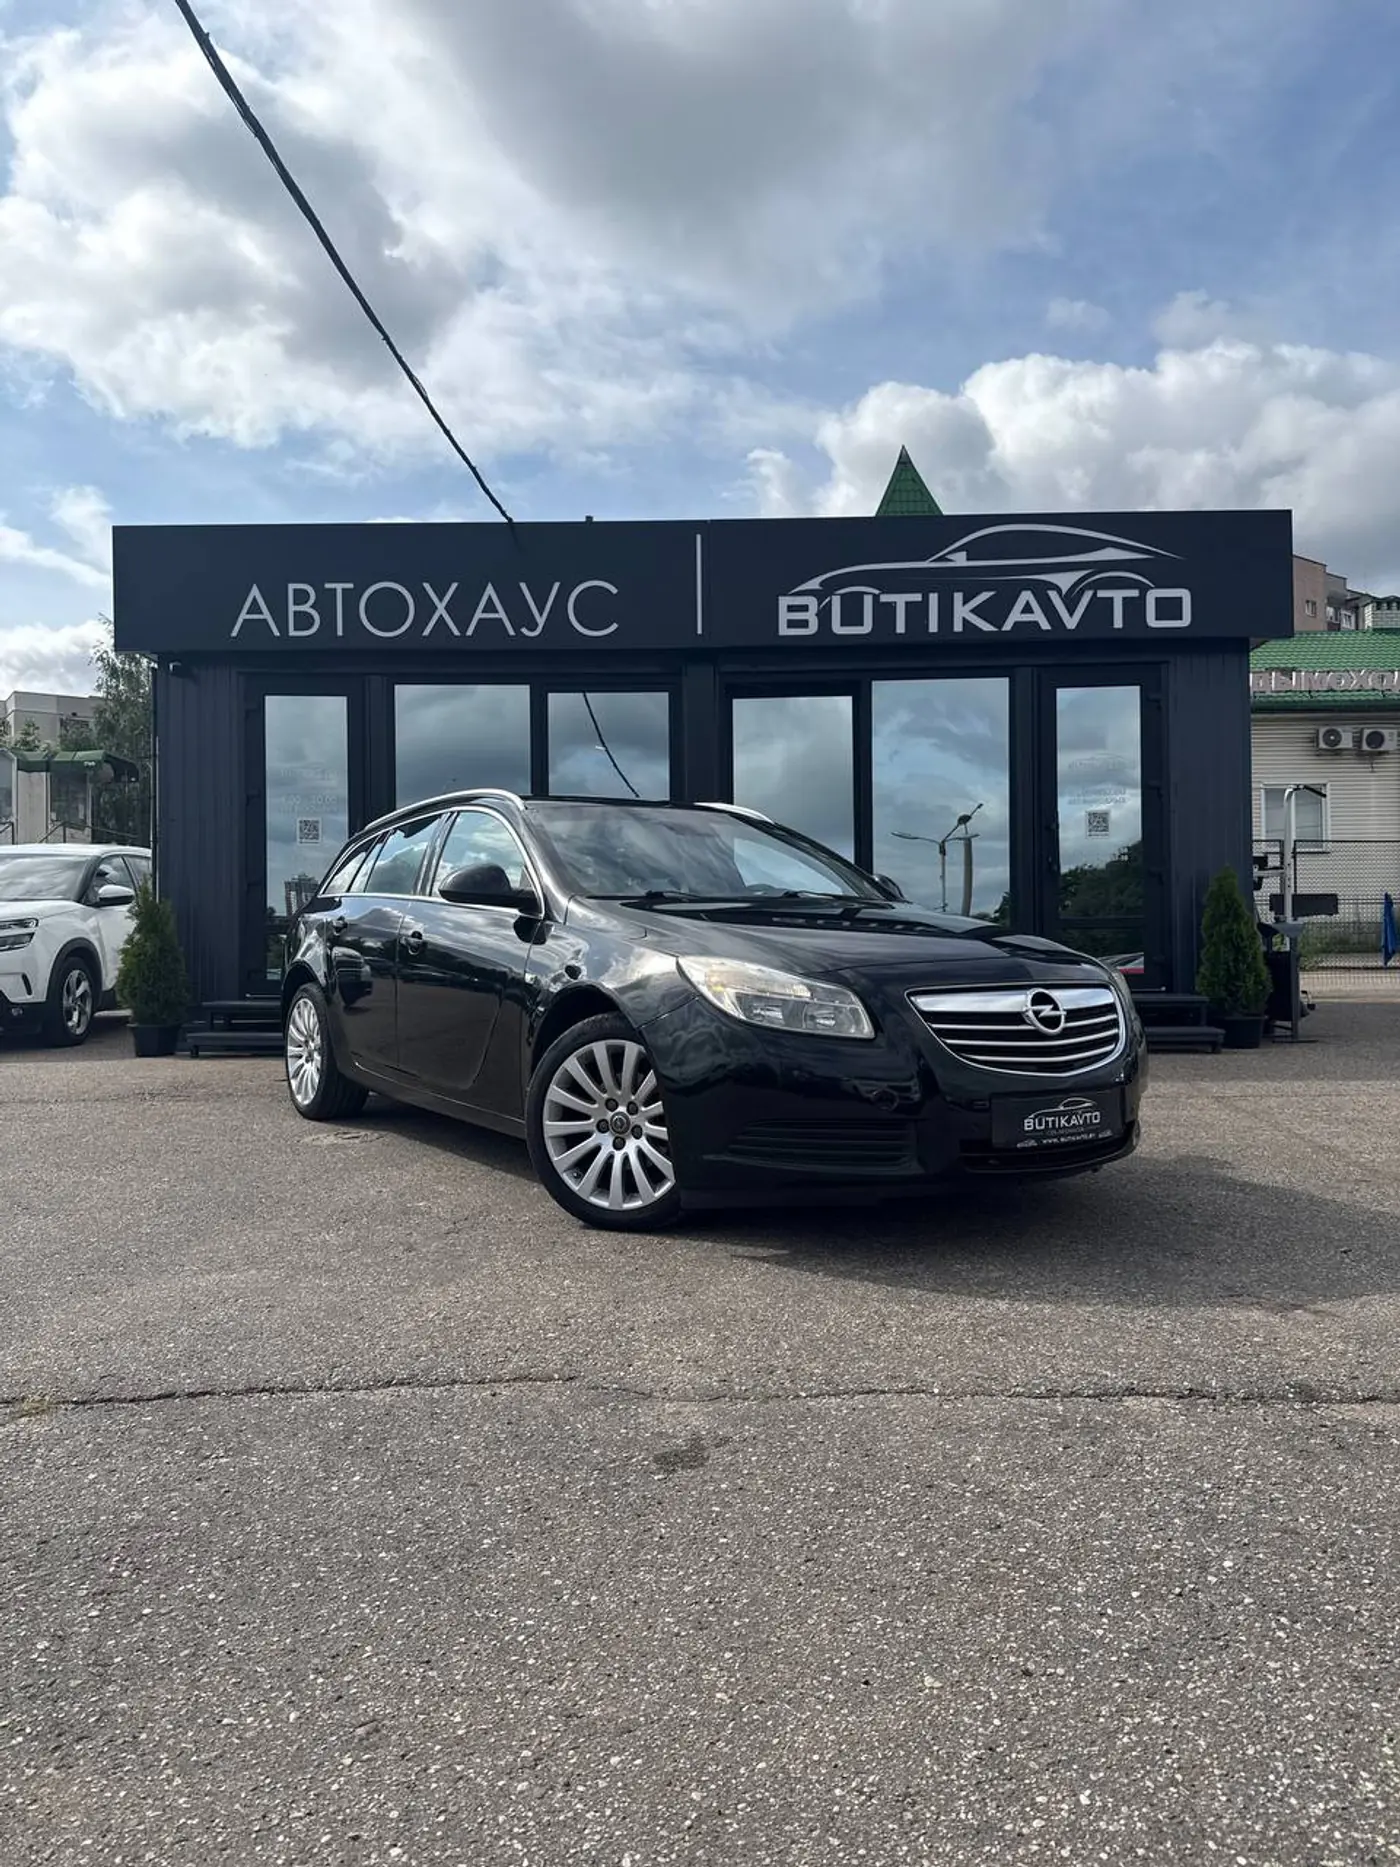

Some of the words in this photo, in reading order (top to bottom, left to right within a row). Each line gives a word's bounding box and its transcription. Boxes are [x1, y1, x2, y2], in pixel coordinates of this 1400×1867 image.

[230, 580, 620, 638] АВТОХАУС
[777, 587, 1193, 637] BUTIKAVTO
[1023, 1111, 1101, 1131] BUTIKAVTO
